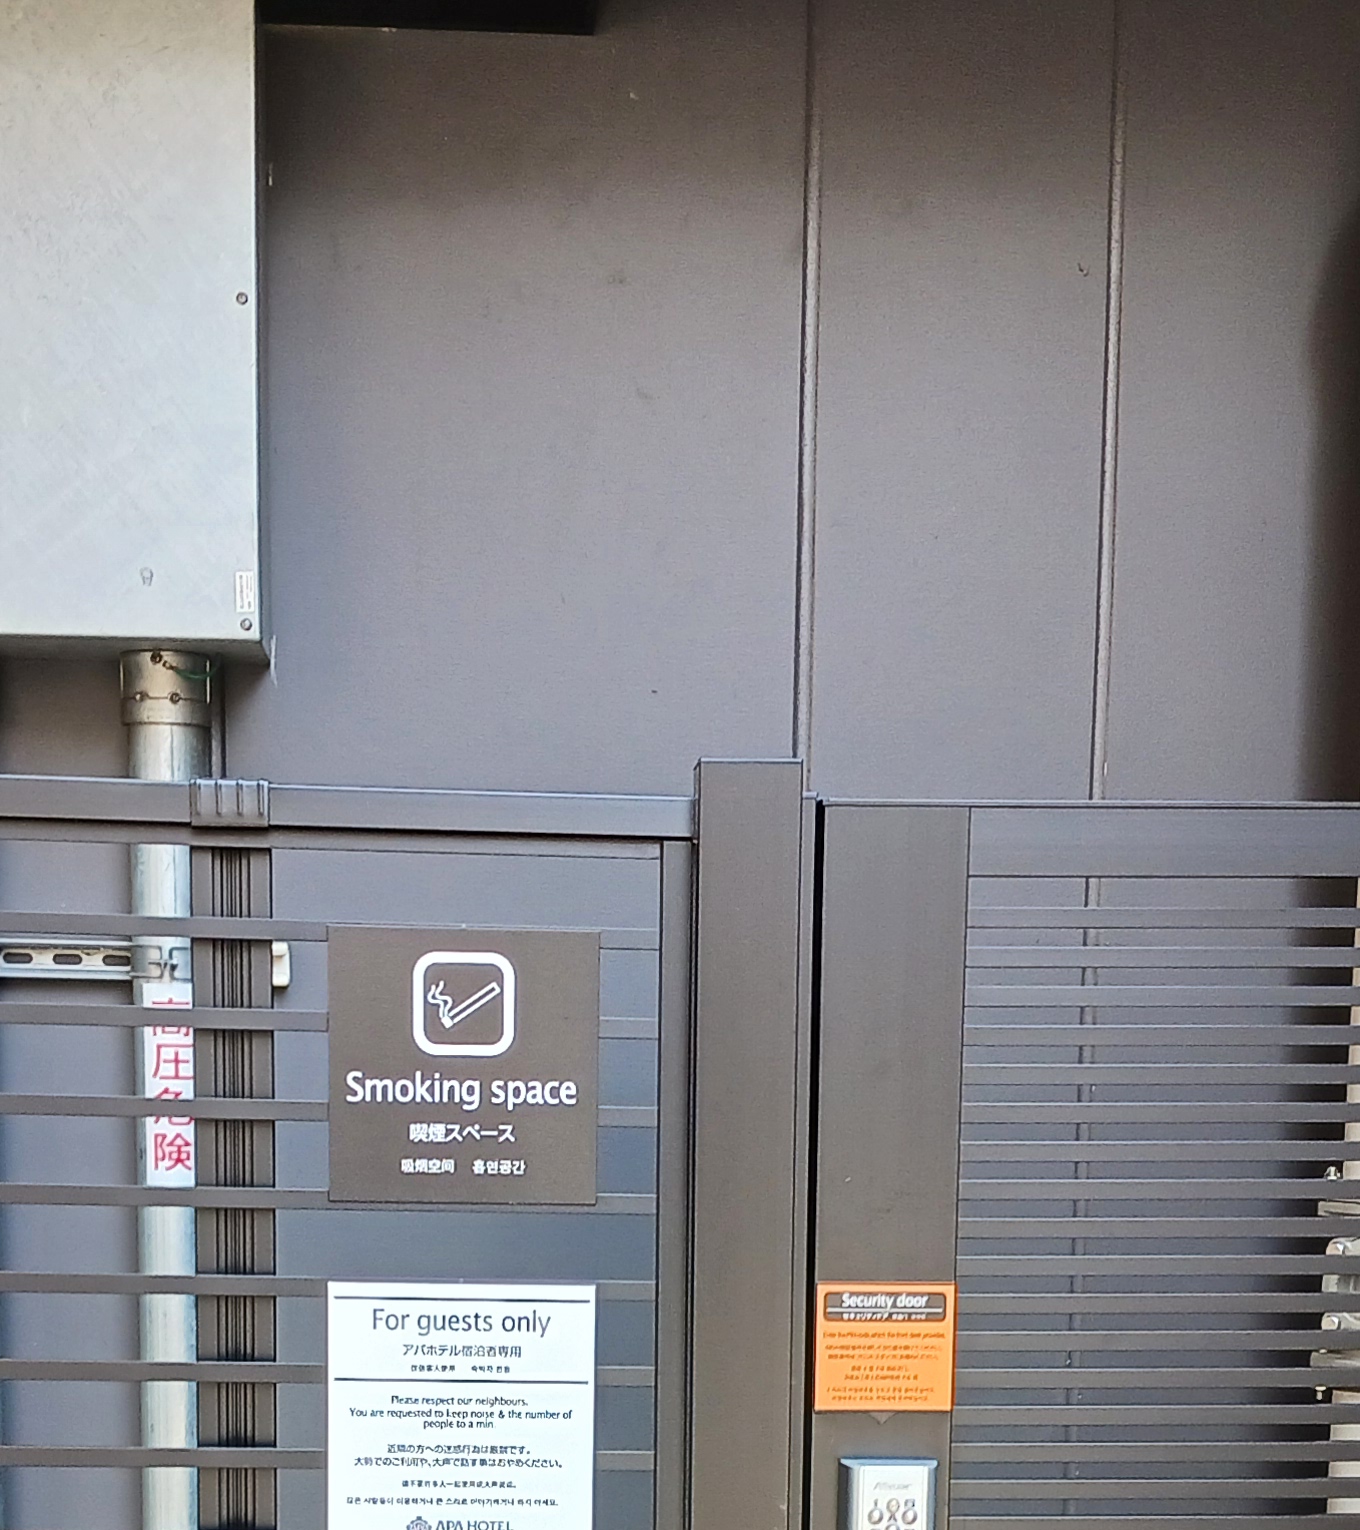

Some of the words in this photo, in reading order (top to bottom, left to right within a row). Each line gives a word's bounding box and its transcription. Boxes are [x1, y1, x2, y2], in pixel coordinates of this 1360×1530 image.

[345, 1070, 481, 1111] Smoking
[490, 1079, 577, 1111] space
[409, 1122, 516, 1143] 喫煙スペース
[842, 1292, 894, 1310] Security
[896, 1292, 929, 1308] door
[372, 1309, 411, 1331] For
[416, 1313, 493, 1337] guests
[501, 1310, 551, 1338] only
[390, 1396, 420, 1405] Please
[421, 1398, 455, 1407] respect
[456, 1398, 474, 1406] our
[475, 1396, 529, 1409] neighbours.
[349, 1408, 368, 1418] You
[369, 1410, 385, 1418] are
[386, 1409, 433, 1420] requested
[446, 1409, 469, 1421] keep
[470, 1411, 495, 1420] noise
[497, 1410, 506, 1419] &
[507, 1410, 523, 1420] the
[524, 1410, 561, 1420] number
[562, 1410, 573, 1420] of
[423, 1419, 455, 1430] people
[456, 1421, 467, 1429] to
[468, 1421, 474, 1429] a
